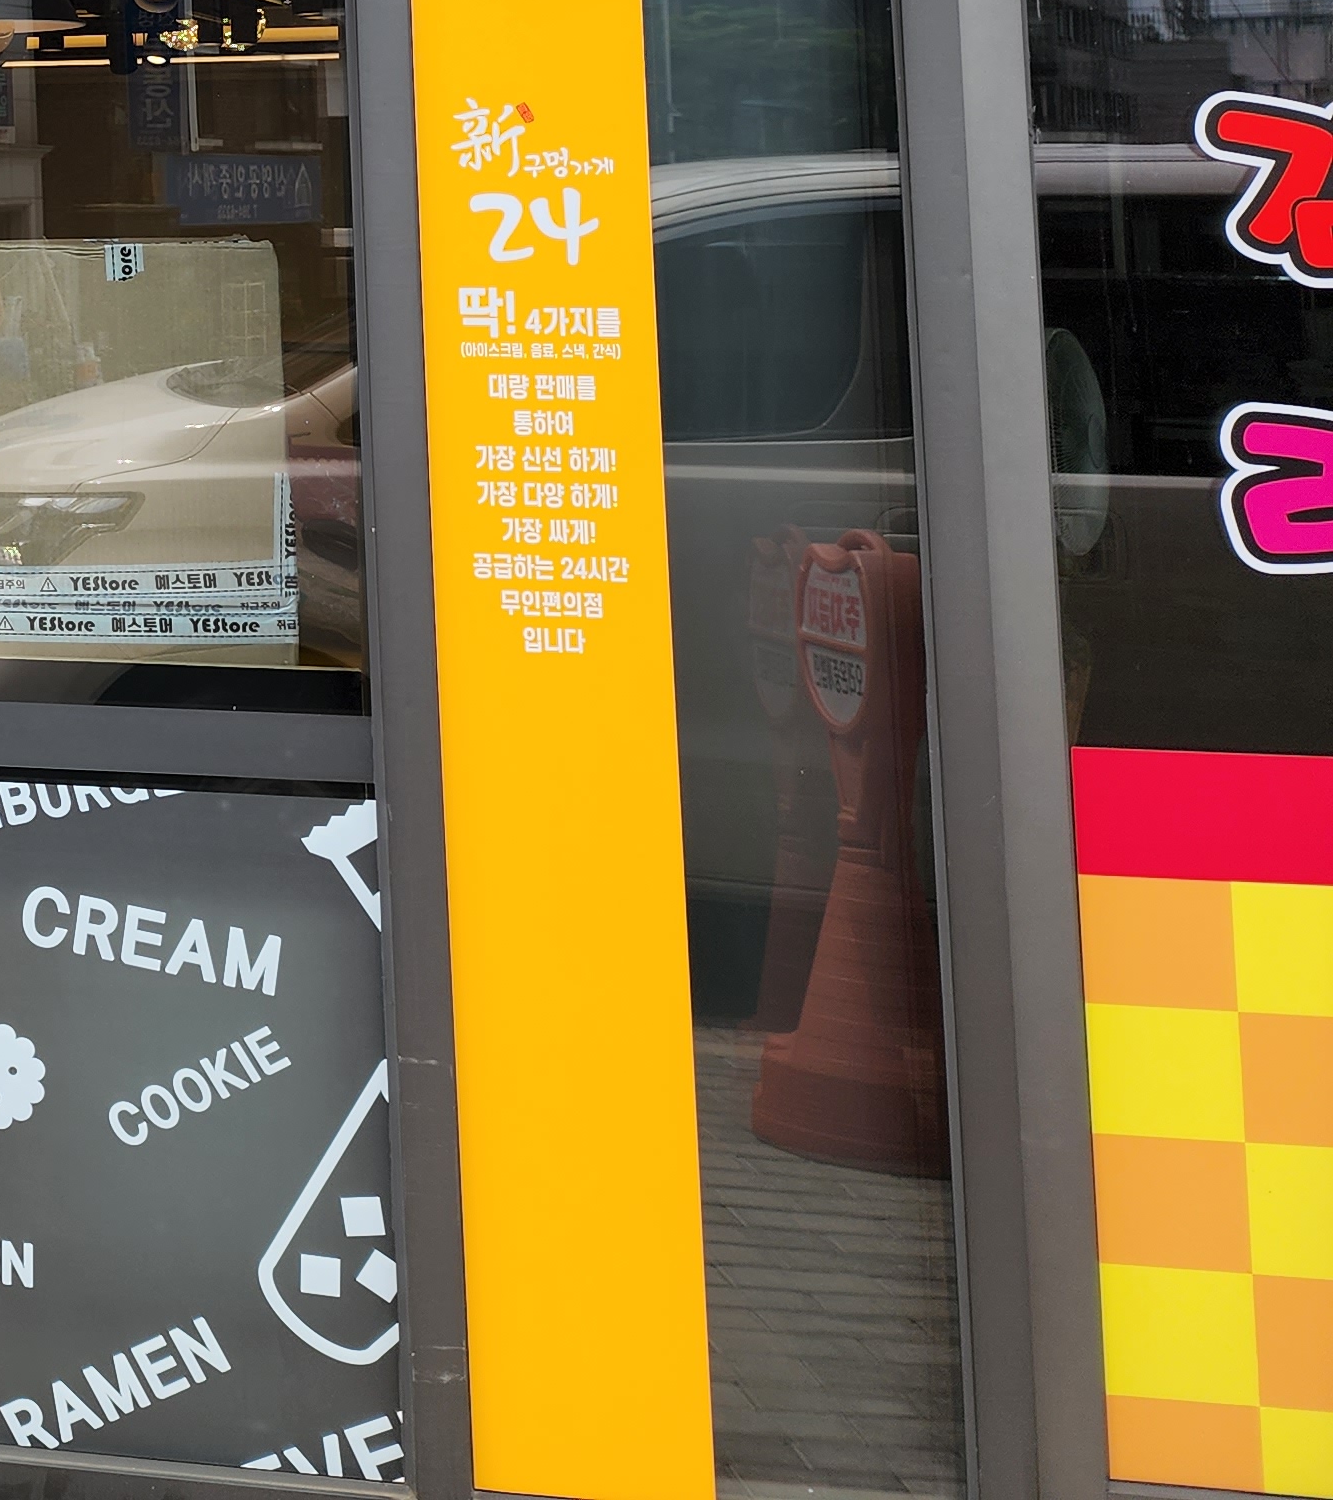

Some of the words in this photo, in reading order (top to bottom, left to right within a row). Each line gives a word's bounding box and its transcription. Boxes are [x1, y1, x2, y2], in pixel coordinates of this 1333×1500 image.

[450, 97, 526, 178] 新
[523, 147, 614, 178] 구멍가게
[469, 187, 599, 266] 24
[458, 286, 516, 339] 딱!
[524, 307, 621, 338] 4가지를
[460, 341, 528, 359] (아이스크림,
[592, 343, 621, 360] 간식)
[488, 373, 529, 400] 대량
[534, 374, 597, 401] 판매를
[513, 410, 574, 436] 통하여
[475, 445, 515, 471] 가장
[521, 446, 562, 472] 신선
[568, 447, 617, 473] 하게!
[476, 481, 516, 507] 가장
[522, 482, 565, 508] 다양
[570, 483, 619, 509] 하게!
[501, 517, 542, 544] 가장
[548, 518, 597, 545] 싸게!
[68, 575, 140, 592] YEStore
[154, 573, 218, 590] 예스토어
[472, 553, 555, 580] 공급하는
[560, 556, 630, 583] 24시간
[500, 589, 604, 619] 무인편의점
[25, 616, 96, 632] YEStore
[111, 616, 174, 633] 예스토어
[189, 616, 261, 633] YEStore
[522, 627, 586, 654] 입니다
[21, 886, 283, 996] CREAM
[108, 1025, 292, 1146] COOKIE
[0, 1315, 232, 1450] RAMEN
